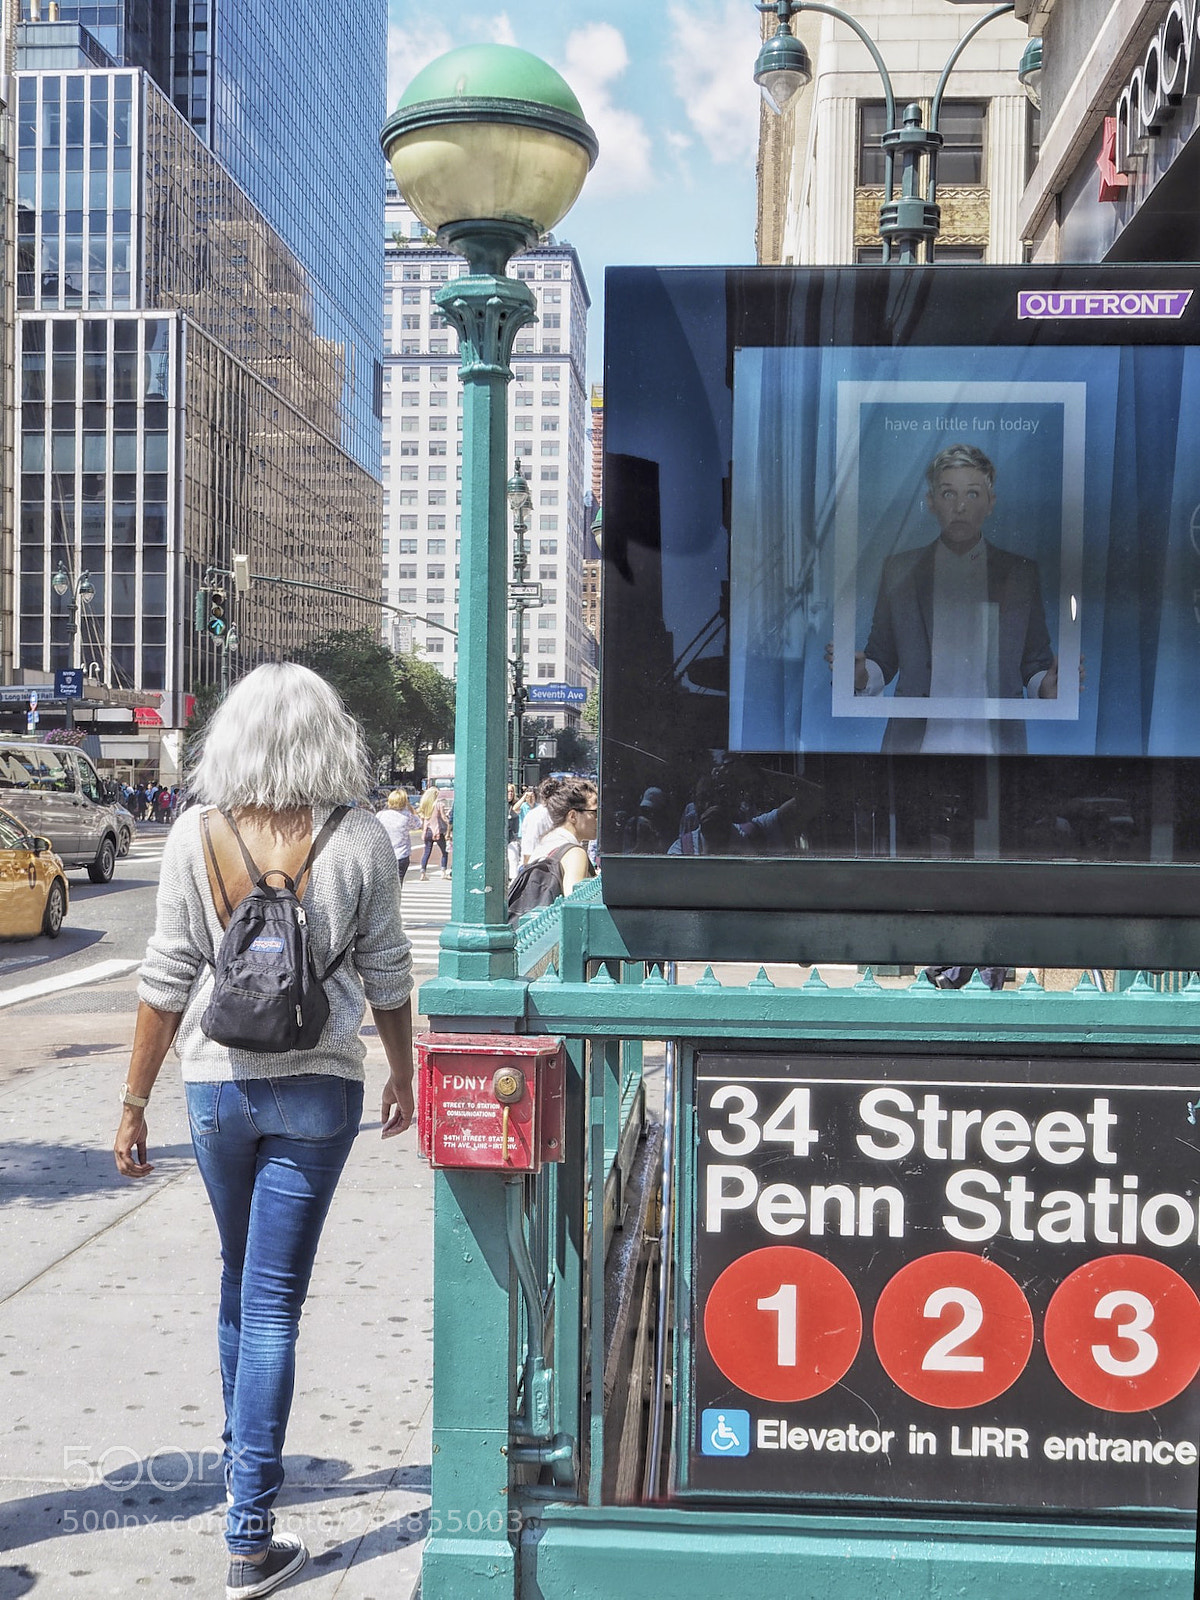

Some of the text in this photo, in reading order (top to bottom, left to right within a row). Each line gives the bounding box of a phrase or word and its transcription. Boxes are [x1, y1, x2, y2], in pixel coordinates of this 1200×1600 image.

[1116, 0, 1200, 174] macy
[1026, 294, 1178, 315] OUTFRONT
[885, 417, 1040, 434] have a little fun today
[532, 689, 584, 700] Seventh Ave
[443, 1075, 487, 1090] FDNY
[446, 1110, 496, 1118] COMMUNICATIONS
[707, 1085, 1118, 1164] 34 Street
[443, 1141, 456, 1149] 7TH
[488, 1135, 515, 1143] STATN
[705, 1164, 1200, 1248] Penn Statio
[757, 1284, 1159, 1377] 1 2 3
[757, 1419, 1197, 1465] Elevator in LIRR entrance
